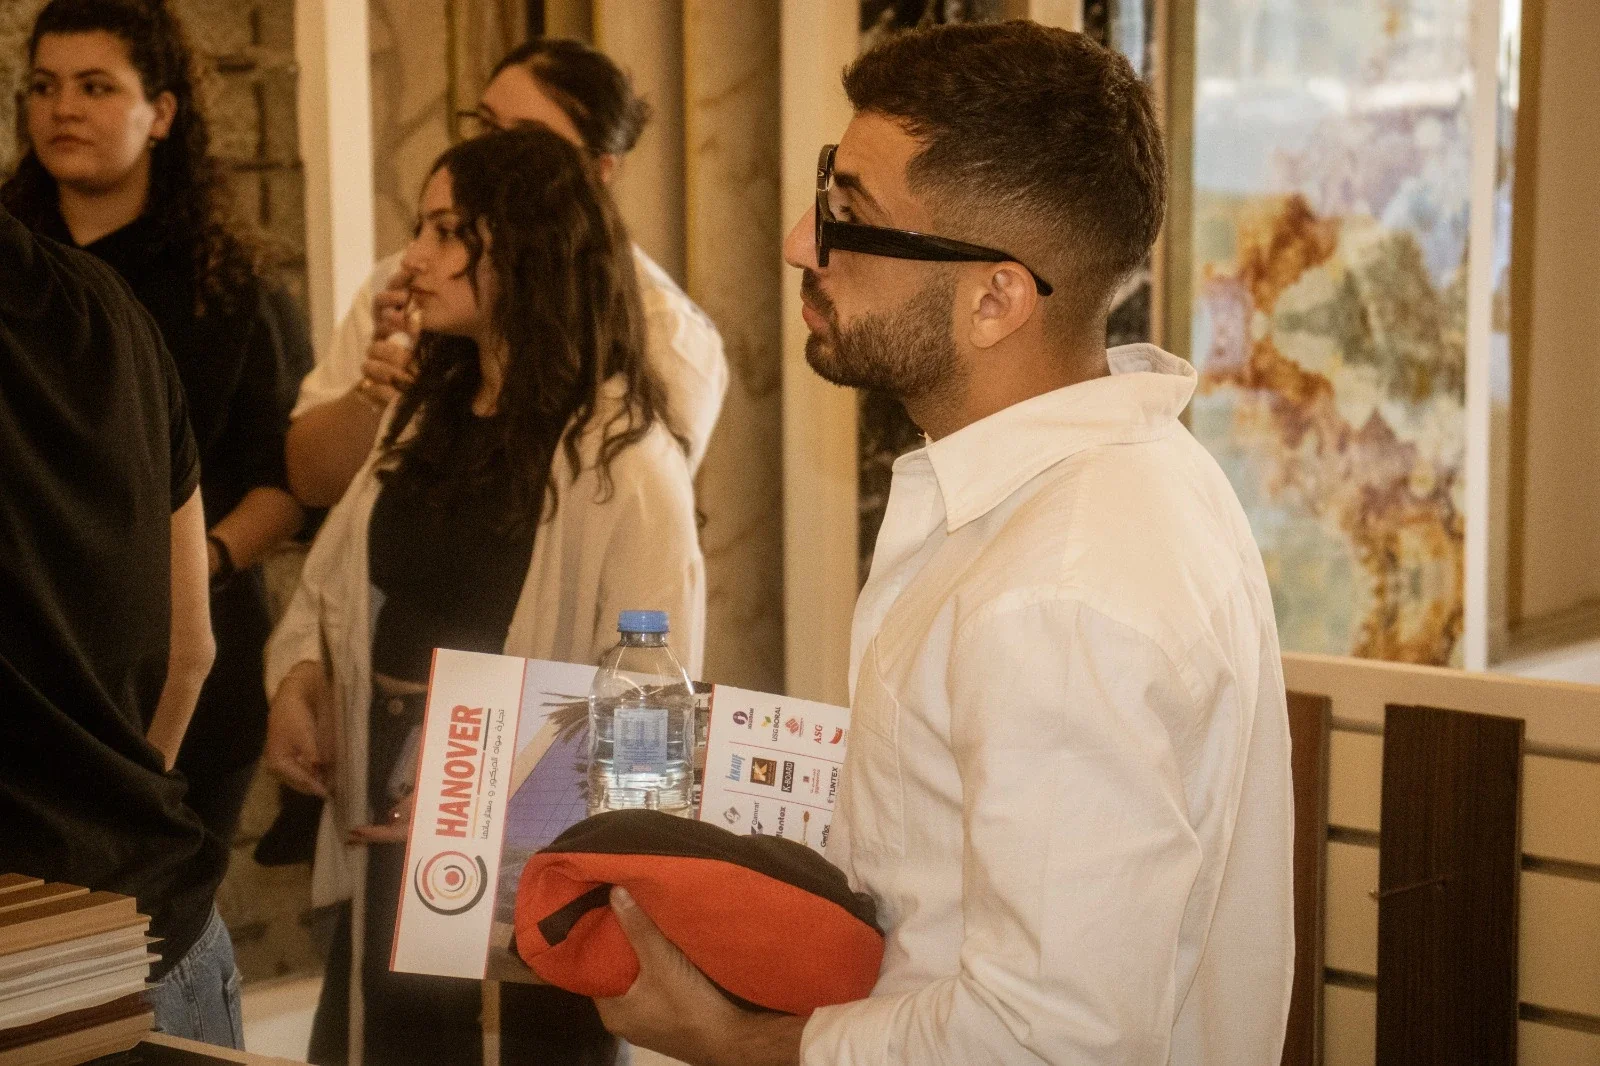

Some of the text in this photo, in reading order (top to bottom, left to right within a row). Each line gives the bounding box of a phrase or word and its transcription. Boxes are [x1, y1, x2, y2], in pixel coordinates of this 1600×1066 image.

[496, 709, 505, 732] تجارة
[773, 706, 781, 728] BORAL
[493, 735, 502, 754] مواد
[813, 724, 823, 744] ASG
[435, 705, 483, 838] HANOVER
[490, 757, 499, 788] الديكور
[725, 754, 745, 781] KNAUF
[782, 761, 793, 792] K-BOARD
[829, 766, 838, 797] TUNTEX
